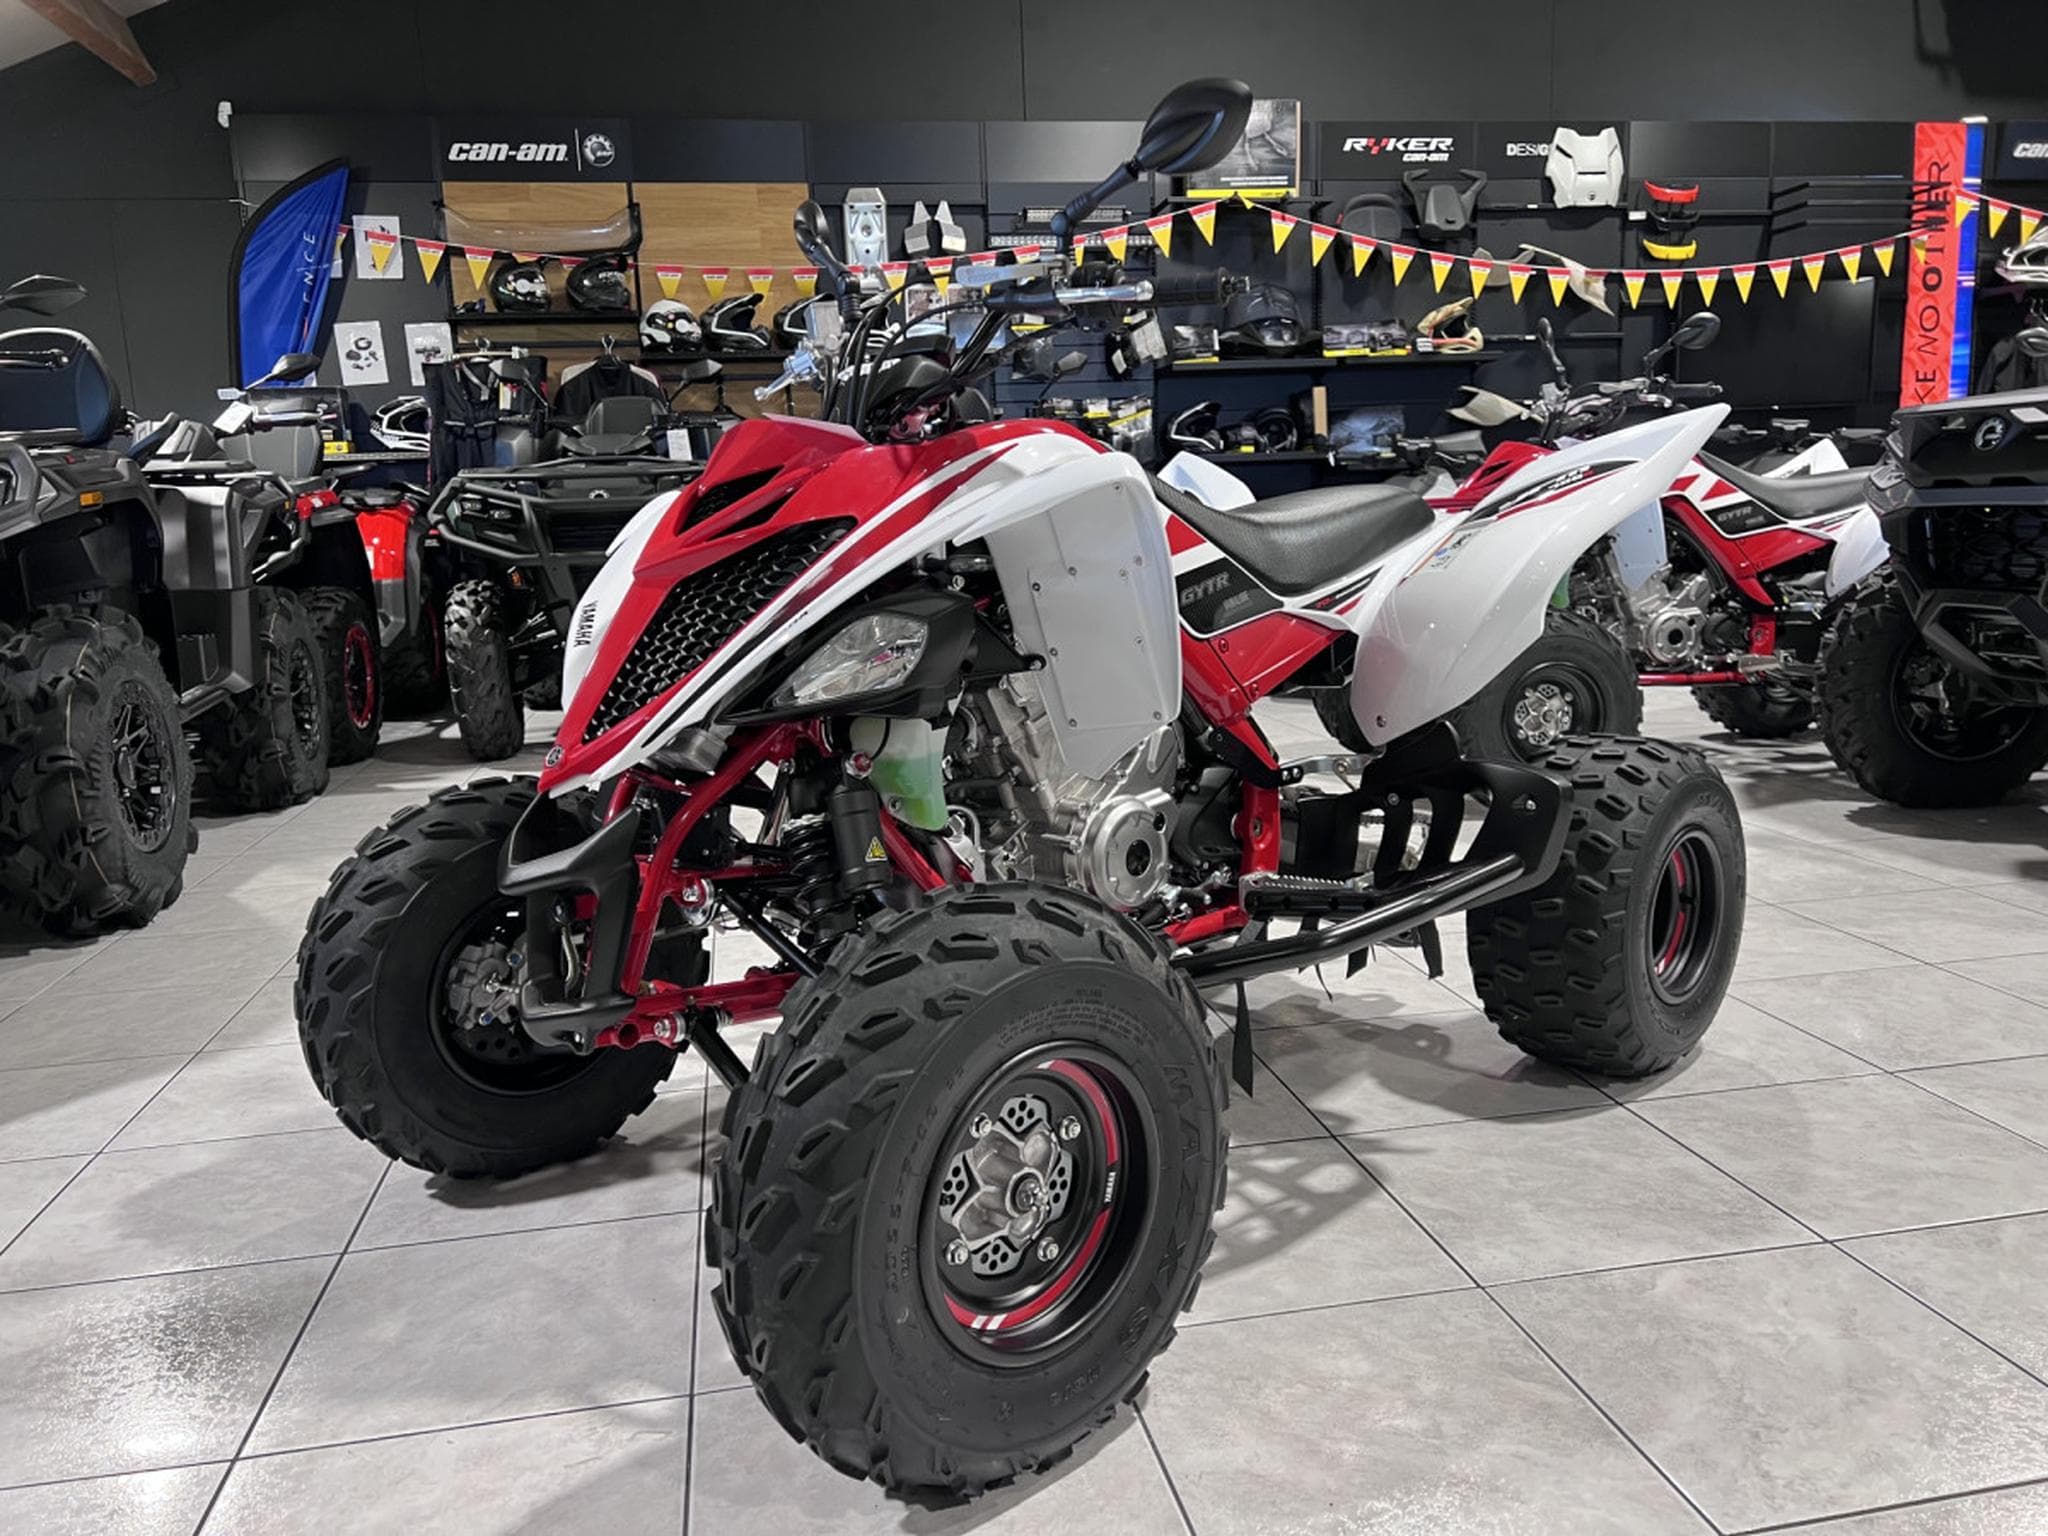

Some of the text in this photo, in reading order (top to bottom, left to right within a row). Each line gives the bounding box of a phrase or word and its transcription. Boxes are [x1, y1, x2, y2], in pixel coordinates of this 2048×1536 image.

[448, 143, 568, 162] can-am
[1343, 137, 1454, 155] RYKER
[1918, 305, 1940, 356] NO
[1181, 571, 1231, 608] GYTR
[573, 600, 599, 648] YAMAHA
